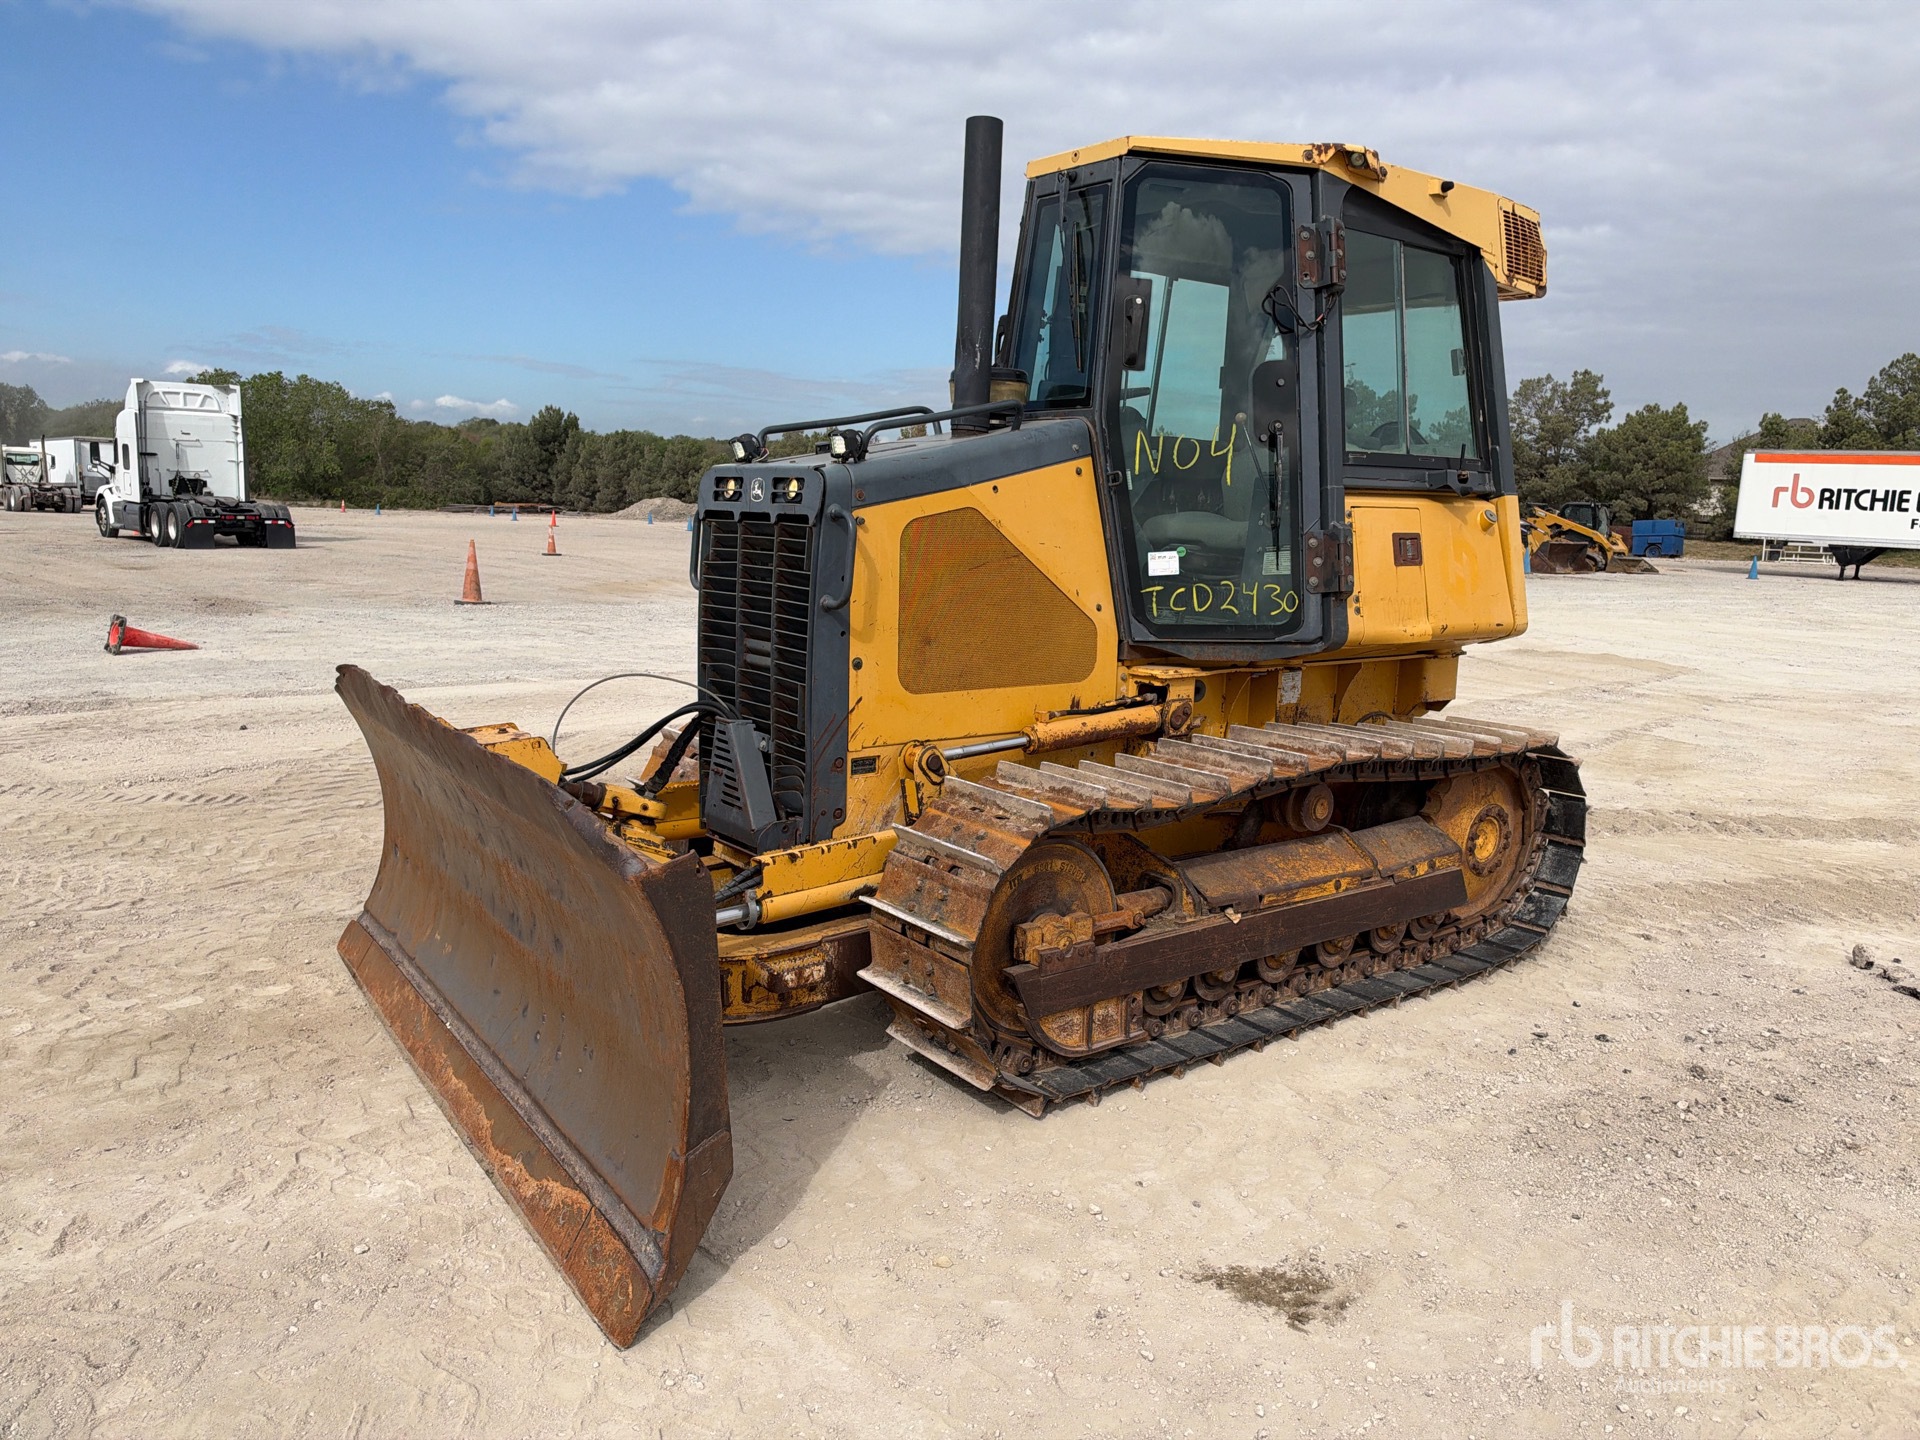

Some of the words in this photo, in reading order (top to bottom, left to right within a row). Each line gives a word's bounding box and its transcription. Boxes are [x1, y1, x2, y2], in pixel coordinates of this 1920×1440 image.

[1771, 473, 1815, 508] rb
[1818, 488, 1912, 513] RITCHIE
[1140, 580, 1299, 617] TCD2430
